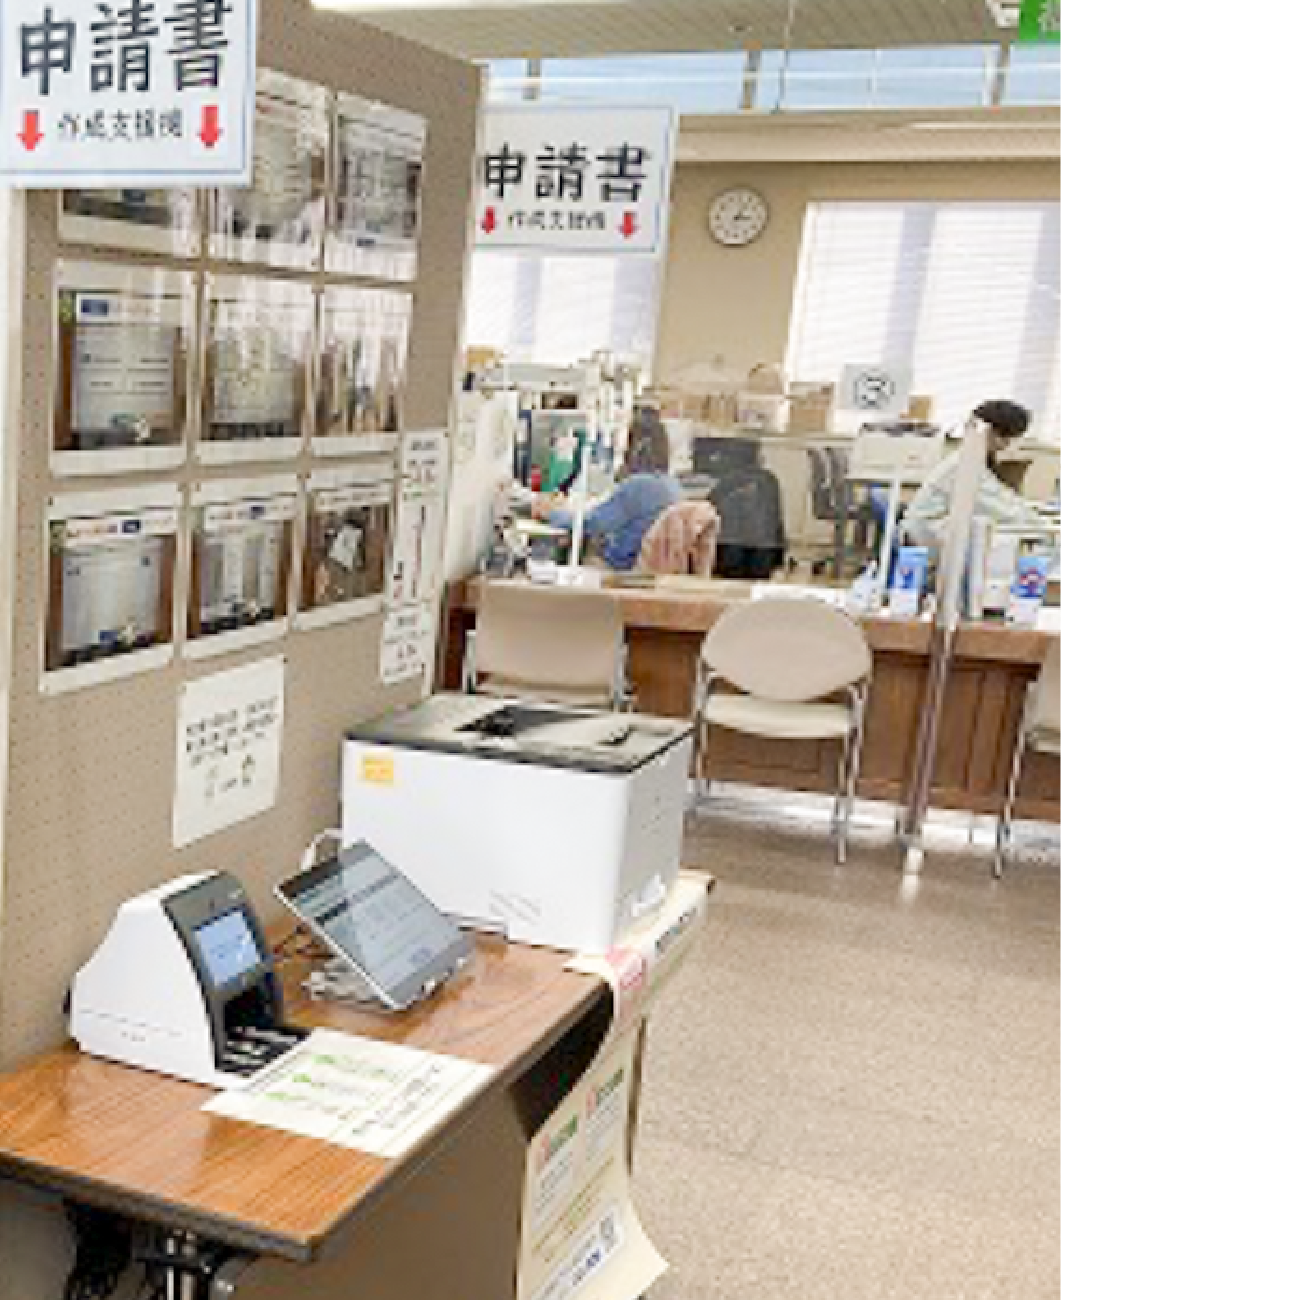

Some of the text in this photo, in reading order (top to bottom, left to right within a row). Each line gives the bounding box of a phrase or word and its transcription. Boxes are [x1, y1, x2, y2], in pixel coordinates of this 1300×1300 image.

[17, 0, 233, 96] 申請書
[483, 142, 650, 202] 申請書
